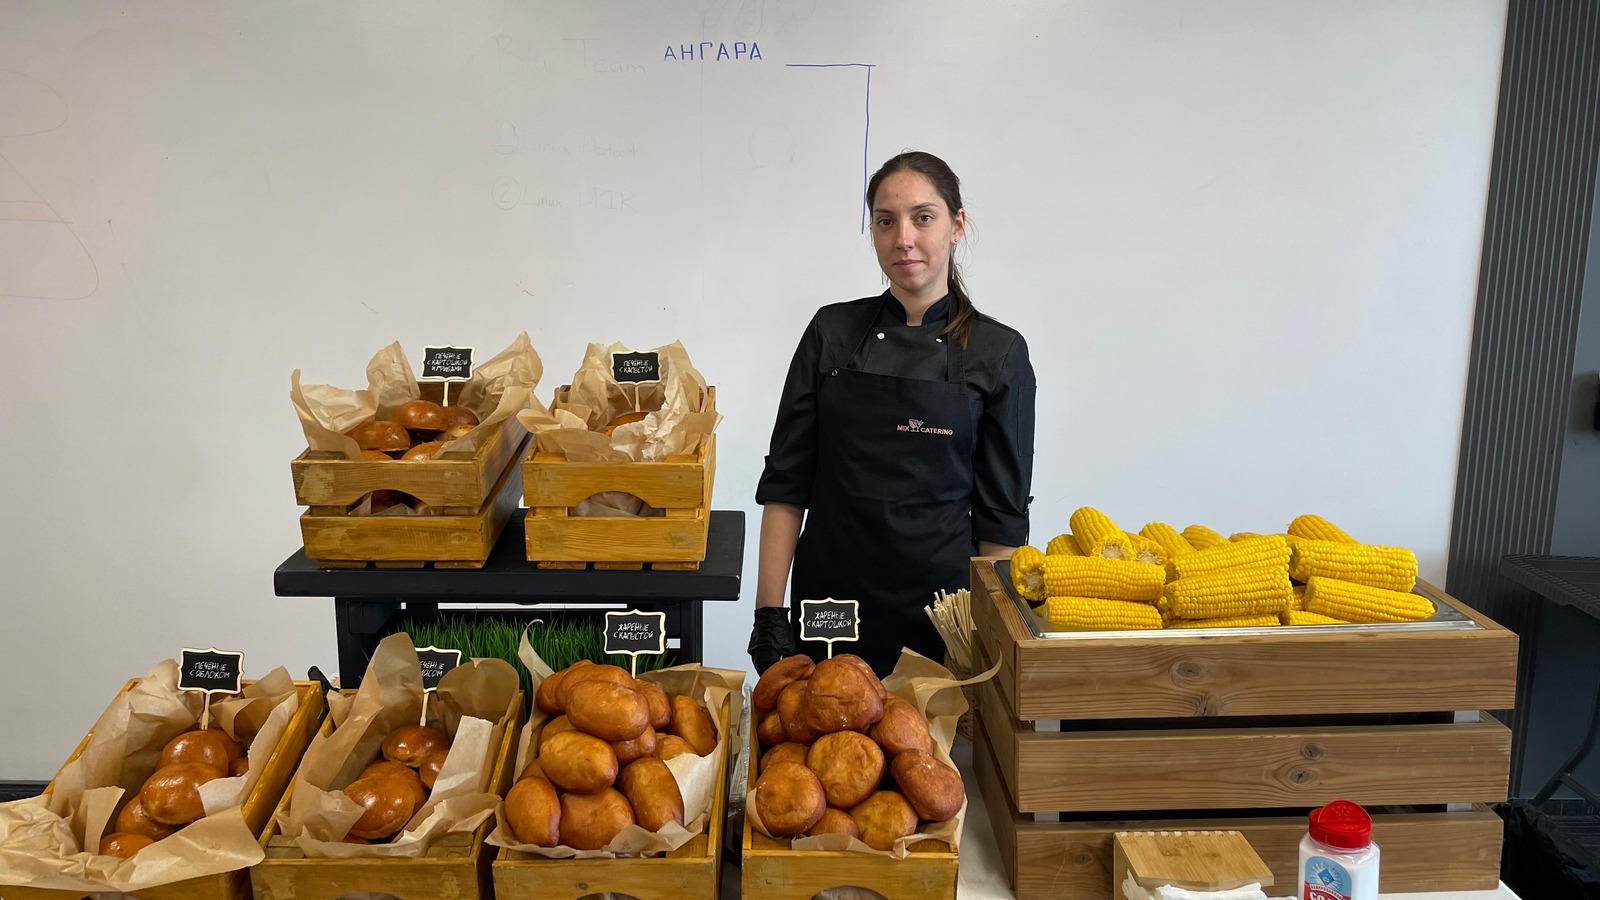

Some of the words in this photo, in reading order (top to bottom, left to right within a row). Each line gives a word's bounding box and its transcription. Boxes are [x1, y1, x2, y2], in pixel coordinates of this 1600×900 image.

[663, 41, 764, 62] АНГАРА
[896, 424, 910, 432] MIX
[920, 427, 954, 436] CATERING
